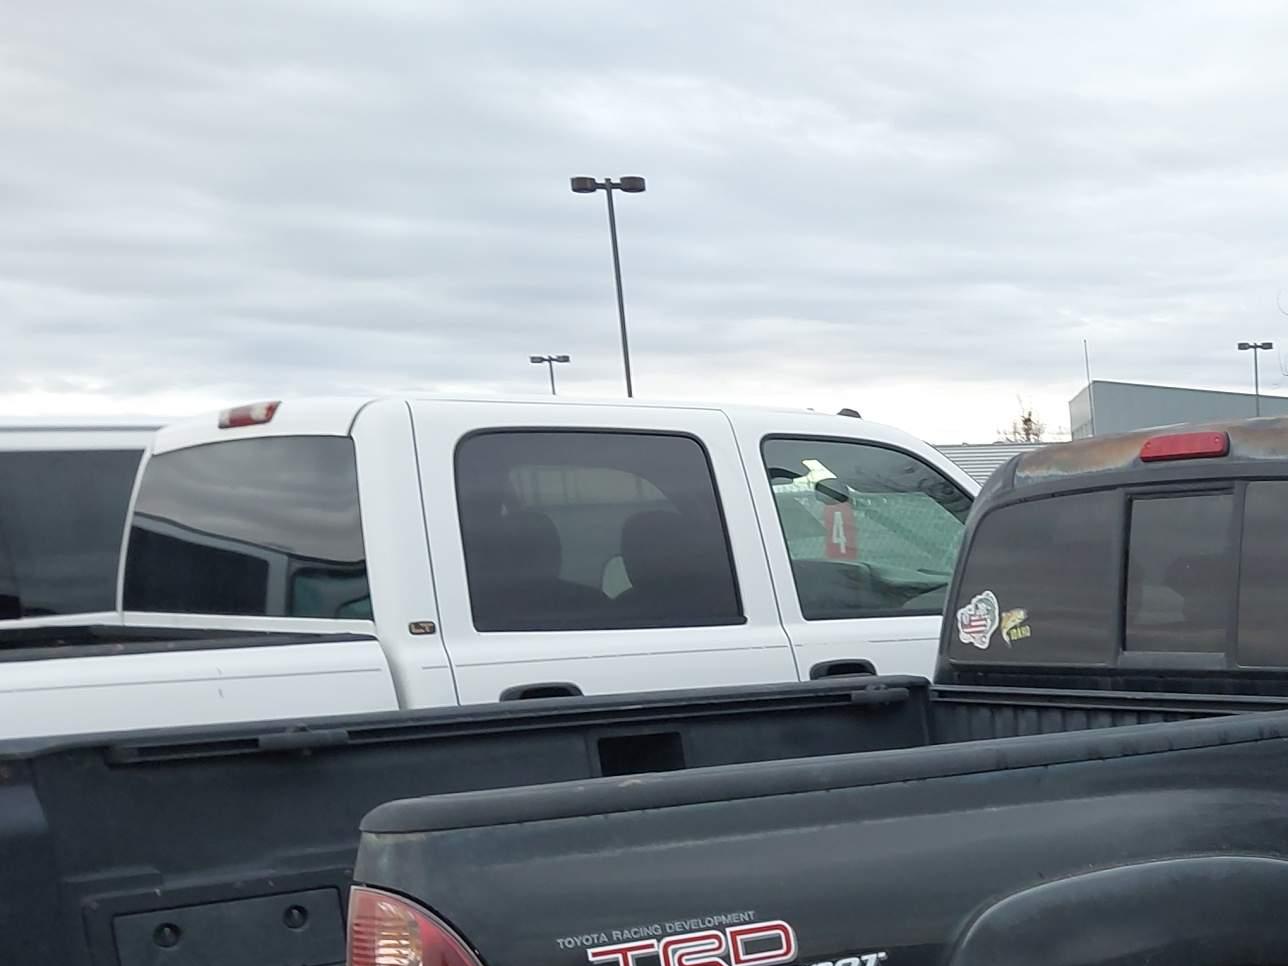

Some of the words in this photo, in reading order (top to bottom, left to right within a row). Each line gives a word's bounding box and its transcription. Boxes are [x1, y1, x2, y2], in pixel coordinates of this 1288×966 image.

[832, 511, 847, 554] 4
[556, 933, 608, 950] TOYOTA
[612, 924, 662, 941] RACING
[665, 910, 755, 933] DEVELOPMENT
